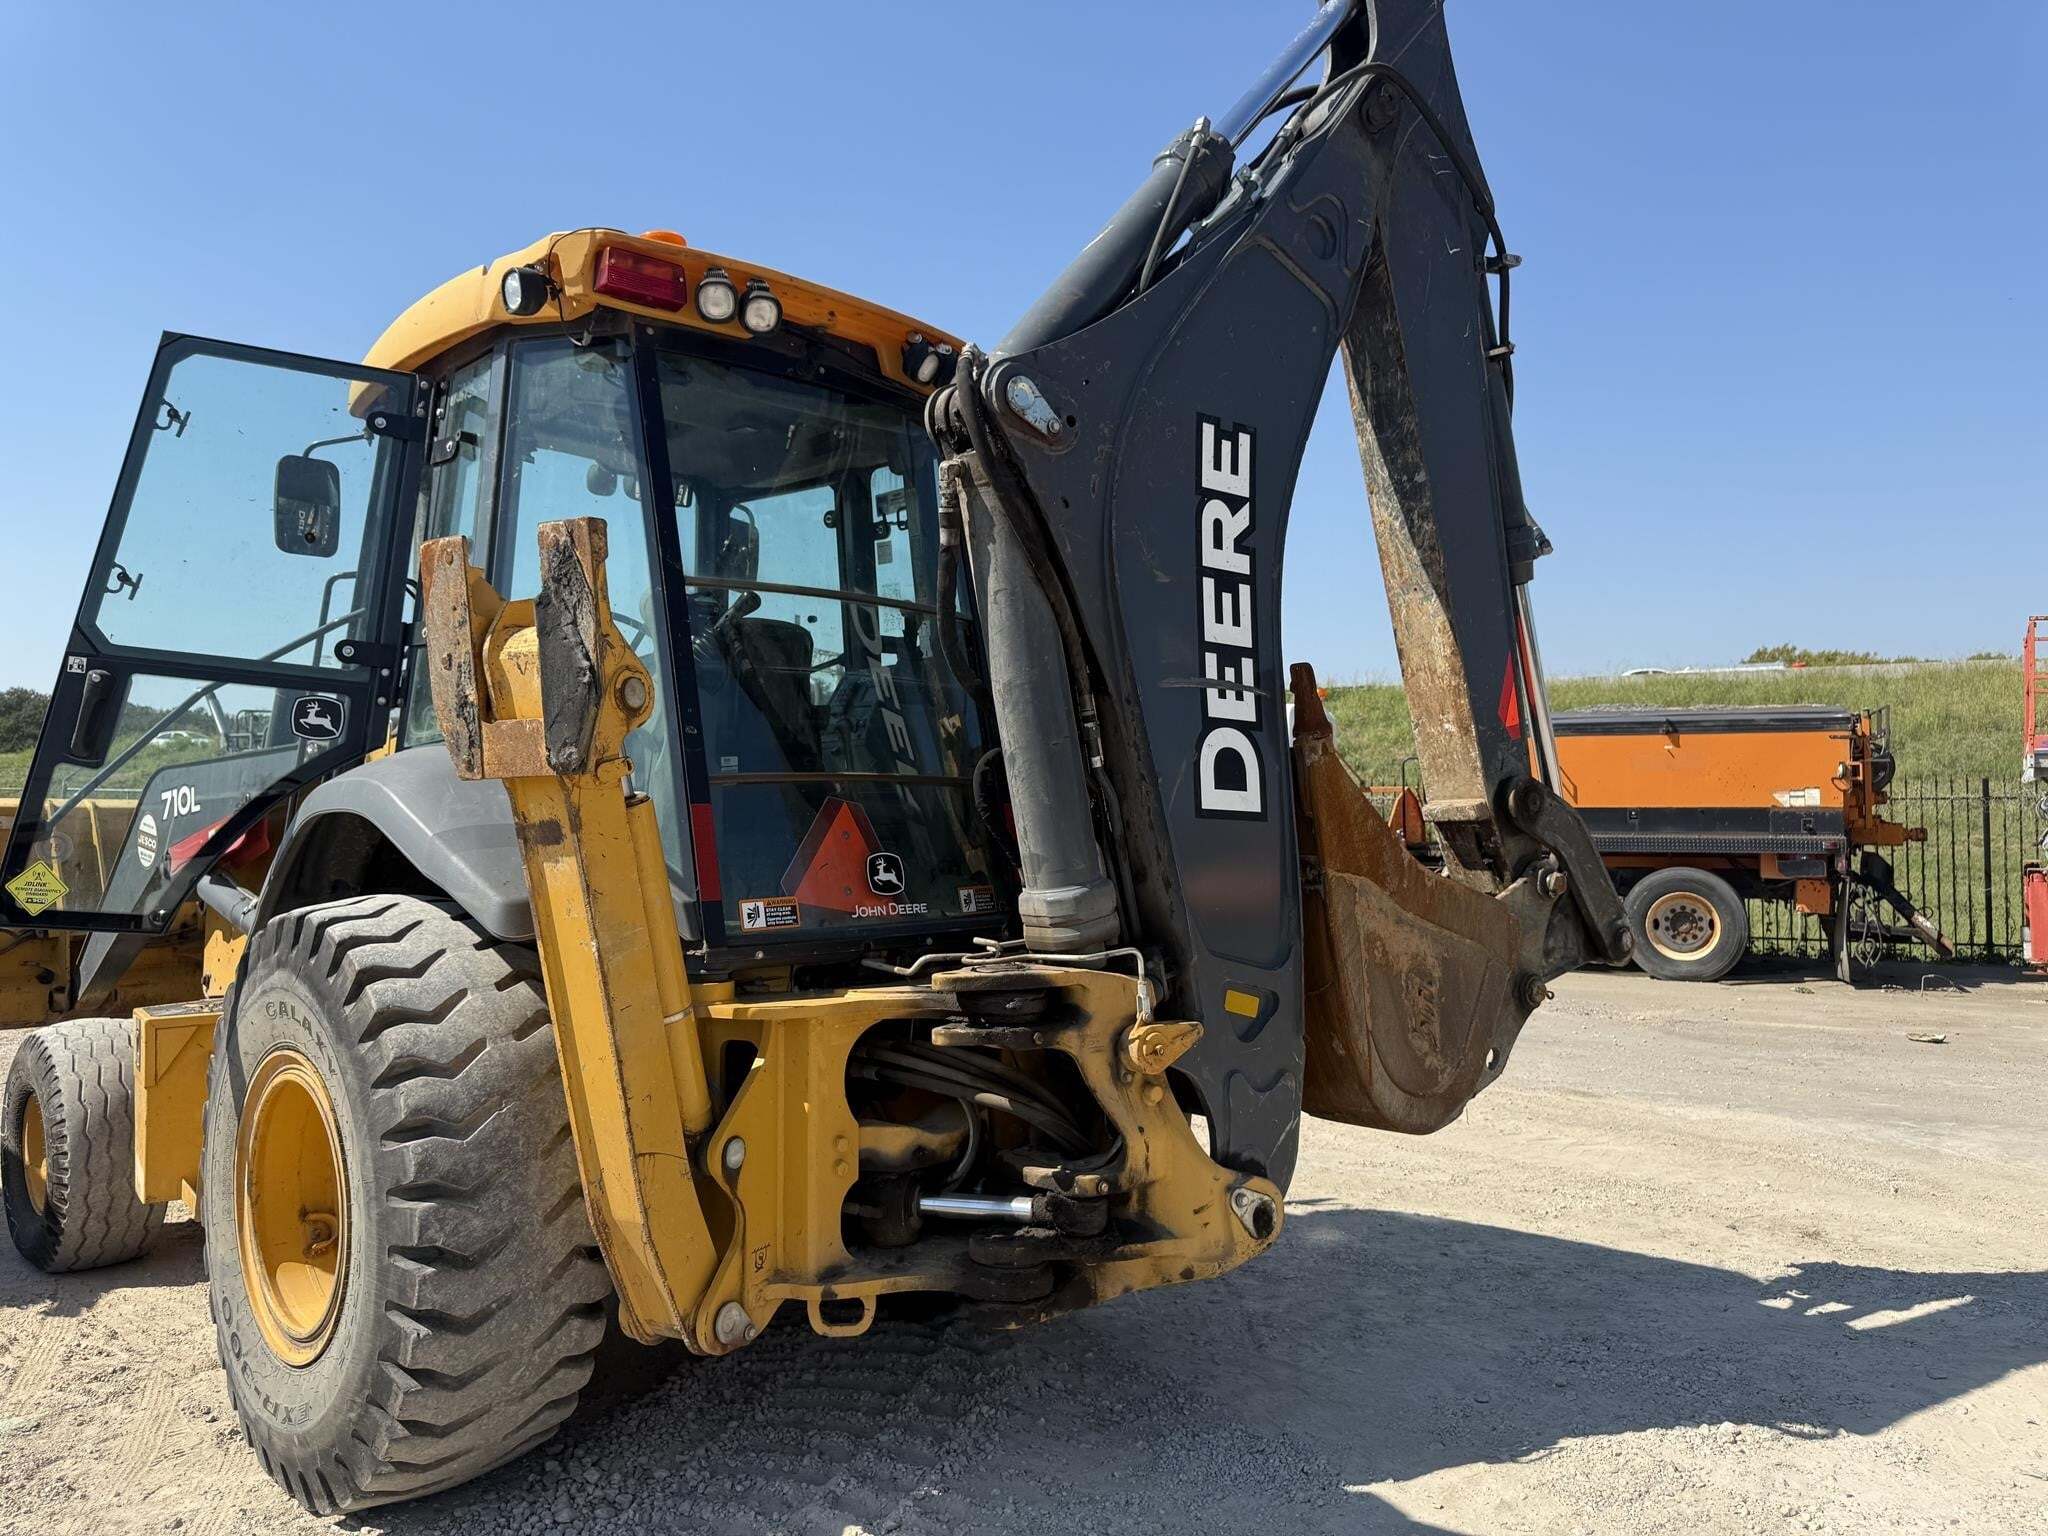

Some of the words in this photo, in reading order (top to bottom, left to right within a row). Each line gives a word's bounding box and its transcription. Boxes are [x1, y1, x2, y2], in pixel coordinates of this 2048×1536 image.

[1201, 422, 1262, 812] DEERE
[161, 785, 201, 820] 710L
[851, 904, 887, 918] JOHN
[888, 902, 929, 915] DEERE
[265, 1001, 339, 1077] GALAXY
